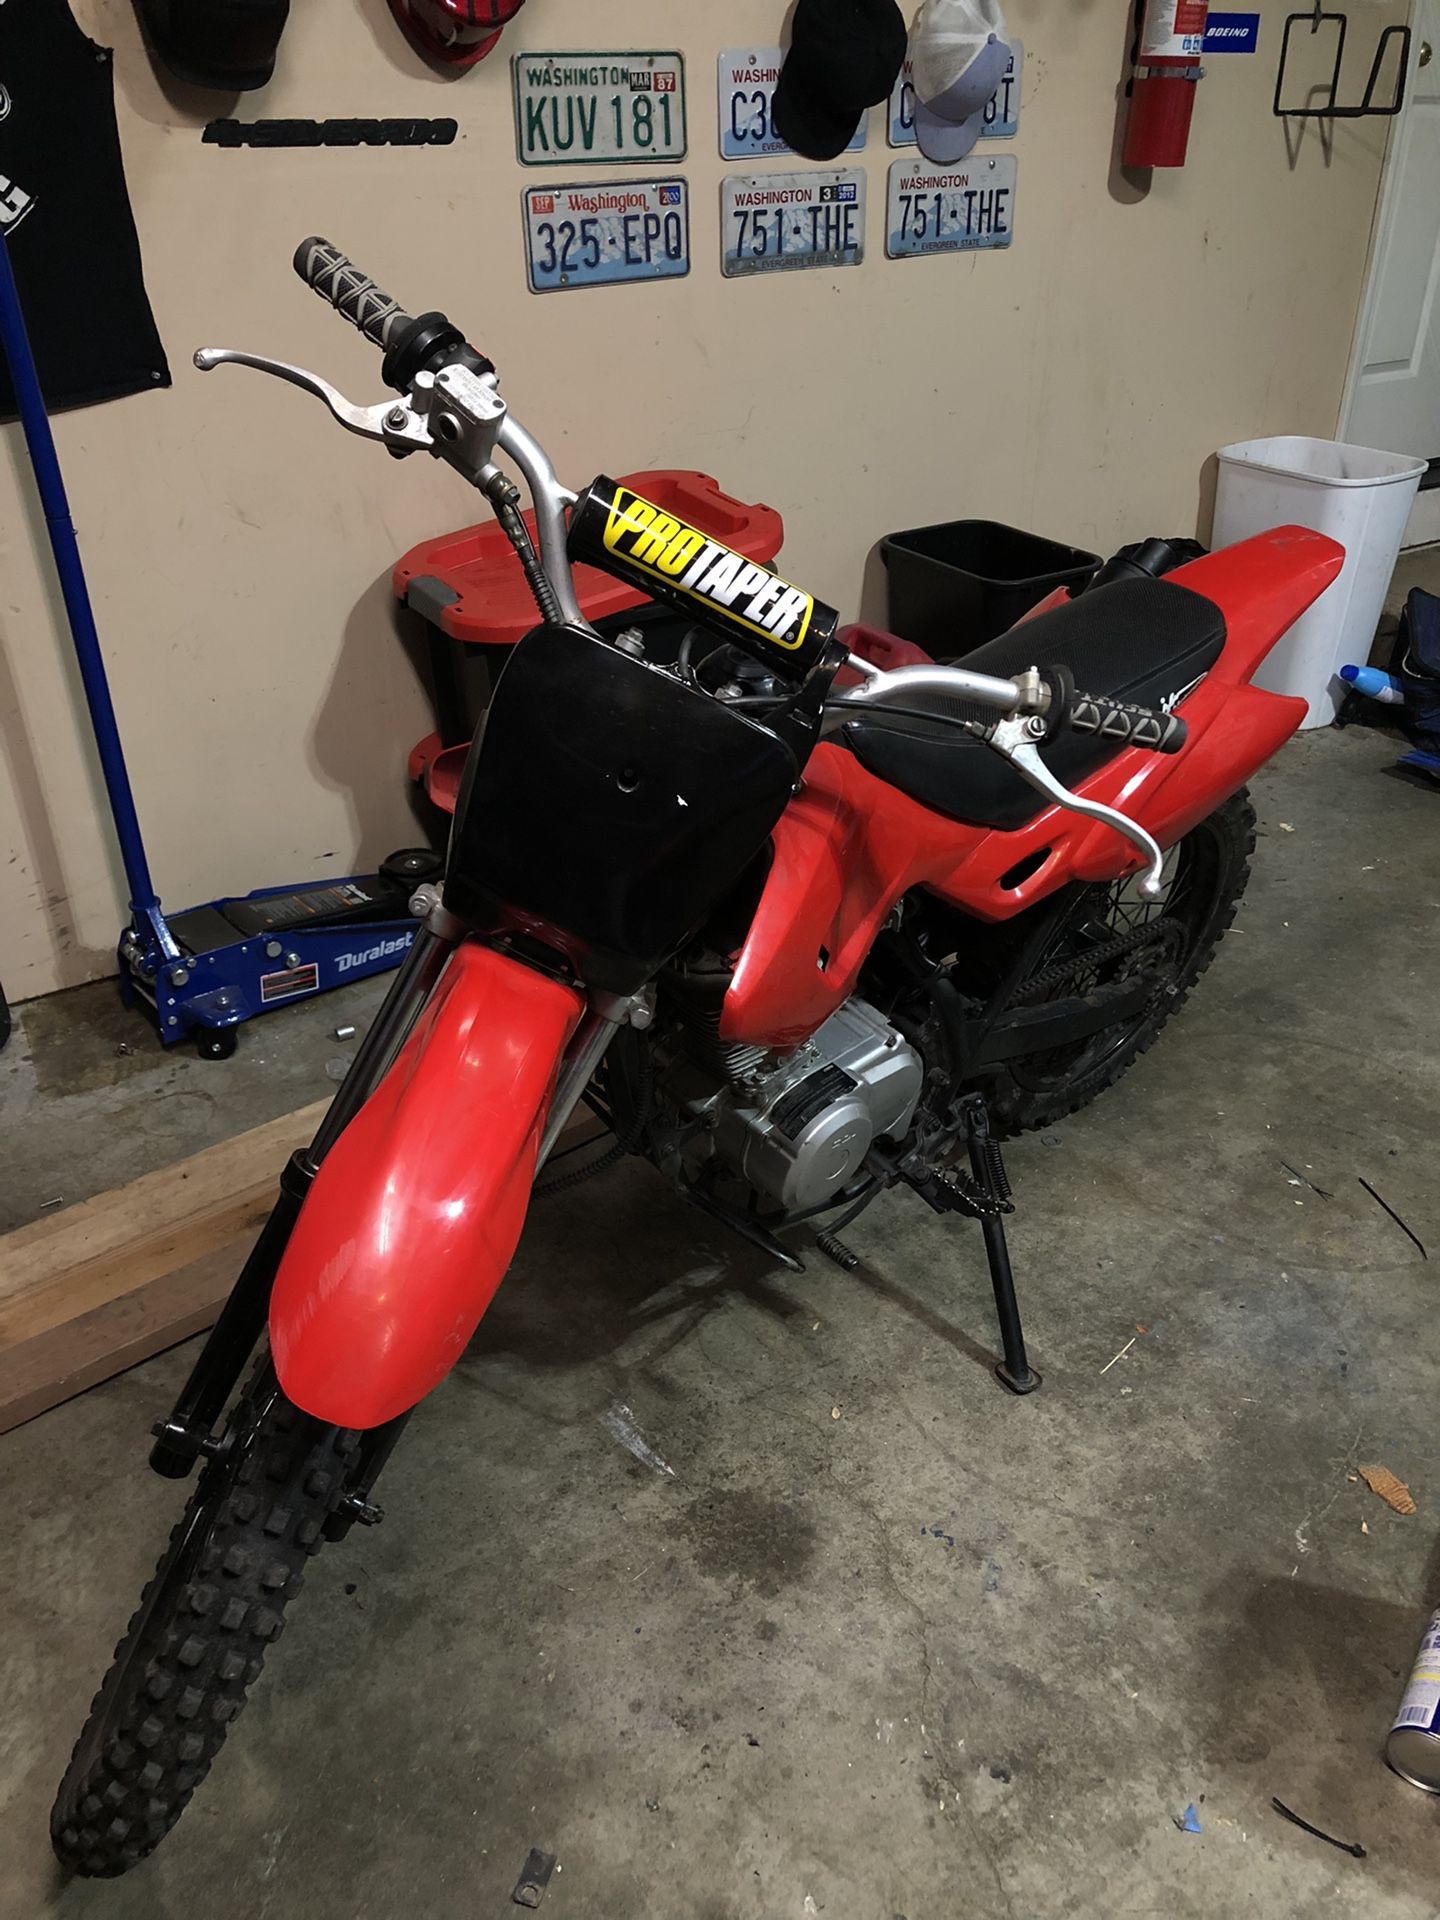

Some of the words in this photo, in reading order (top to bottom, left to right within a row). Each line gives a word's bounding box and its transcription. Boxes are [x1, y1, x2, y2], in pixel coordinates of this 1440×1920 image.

[1206, 27, 1249, 38] BOEING
[526, 66, 629, 87] WASHINGTON
[631, 72, 650, 87] MAR
[732, 68, 781, 84] WASHIN
[657, 79, 673, 90] 87
[526, 95, 597, 152] KUV
[611, 93, 671, 149] 181
[900, 175, 969, 190] WASHINGTON
[735, 189, 812, 206] WASHINGTON
[823, 187, 831, 200] 3
[567, 192, 650, 214] Washington
[921, 241, 958, 251] EVERGREEN
[961, 238, 980, 248] STATE
[334, 931, 413, 972] Duralast
